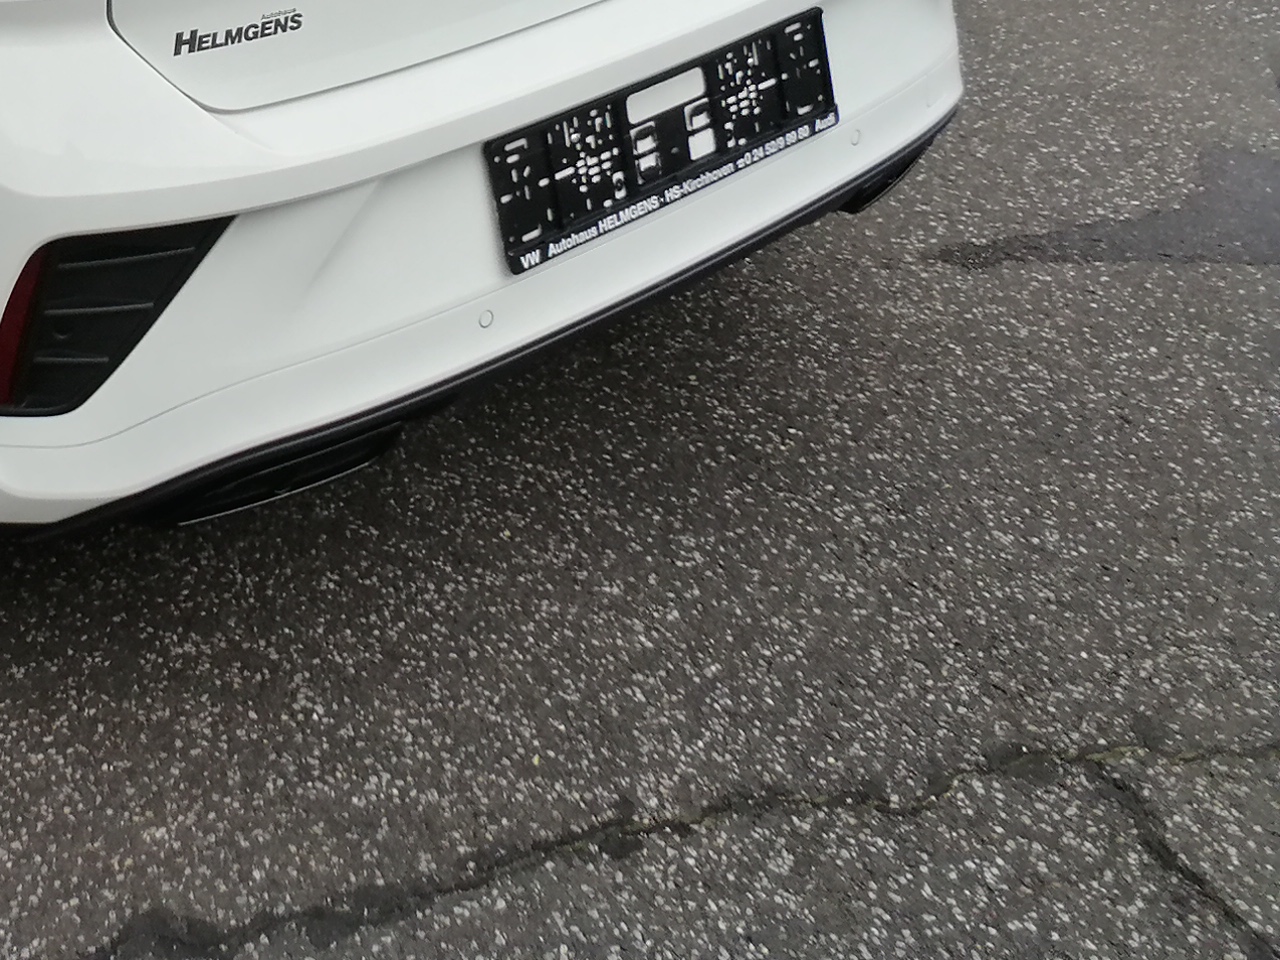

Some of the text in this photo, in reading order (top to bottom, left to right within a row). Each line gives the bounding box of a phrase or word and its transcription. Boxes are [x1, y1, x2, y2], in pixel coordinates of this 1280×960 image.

[520, 248, 541, 269] VW
[548, 226, 598, 257] Autohaus
[598, 195, 660, 233] HELMGENS
[814, 112, 836, 132] Audi
